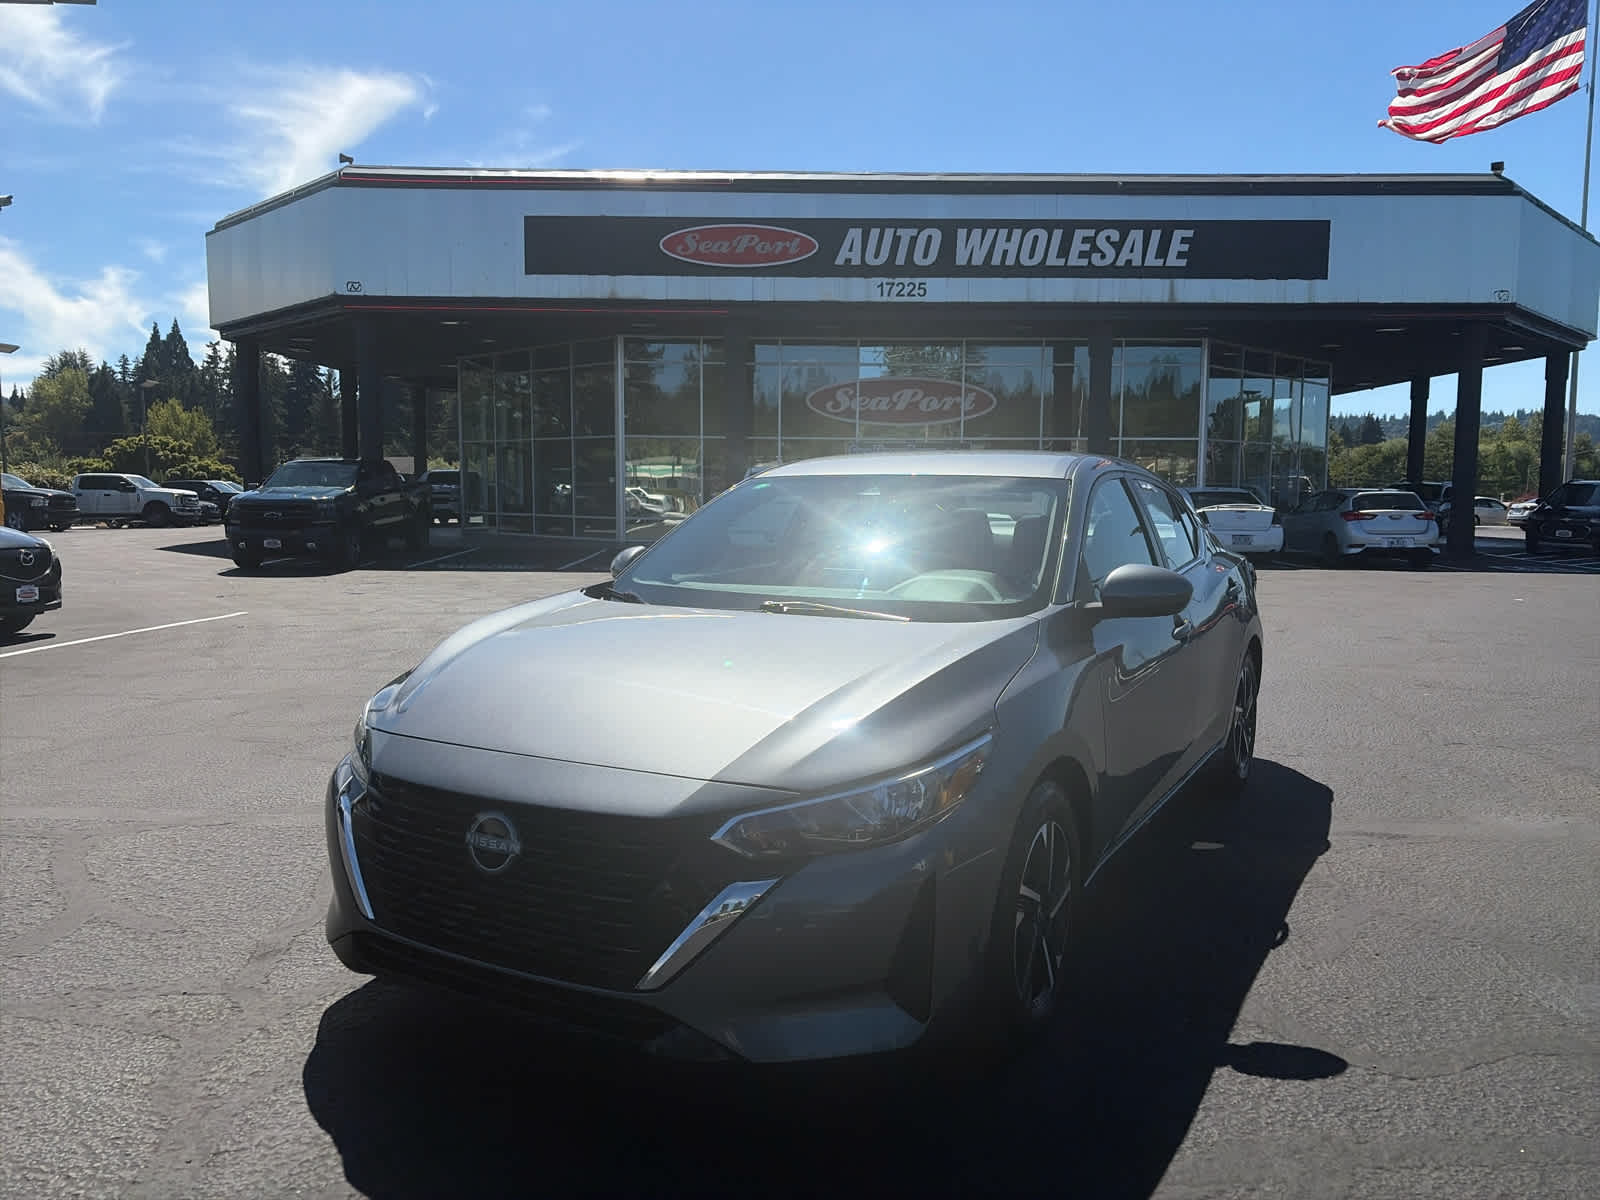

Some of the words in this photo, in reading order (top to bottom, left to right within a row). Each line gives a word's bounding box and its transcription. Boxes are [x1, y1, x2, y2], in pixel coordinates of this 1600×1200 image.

[676, 232, 801, 257] SeaPort
[834, 228, 942, 267] AUTO
[955, 229, 1194, 267] WHOLESALE
[876, 281, 928, 298] 17225
[826, 388, 976, 412] SeaPort
[465, 833, 520, 854] NISSAN
